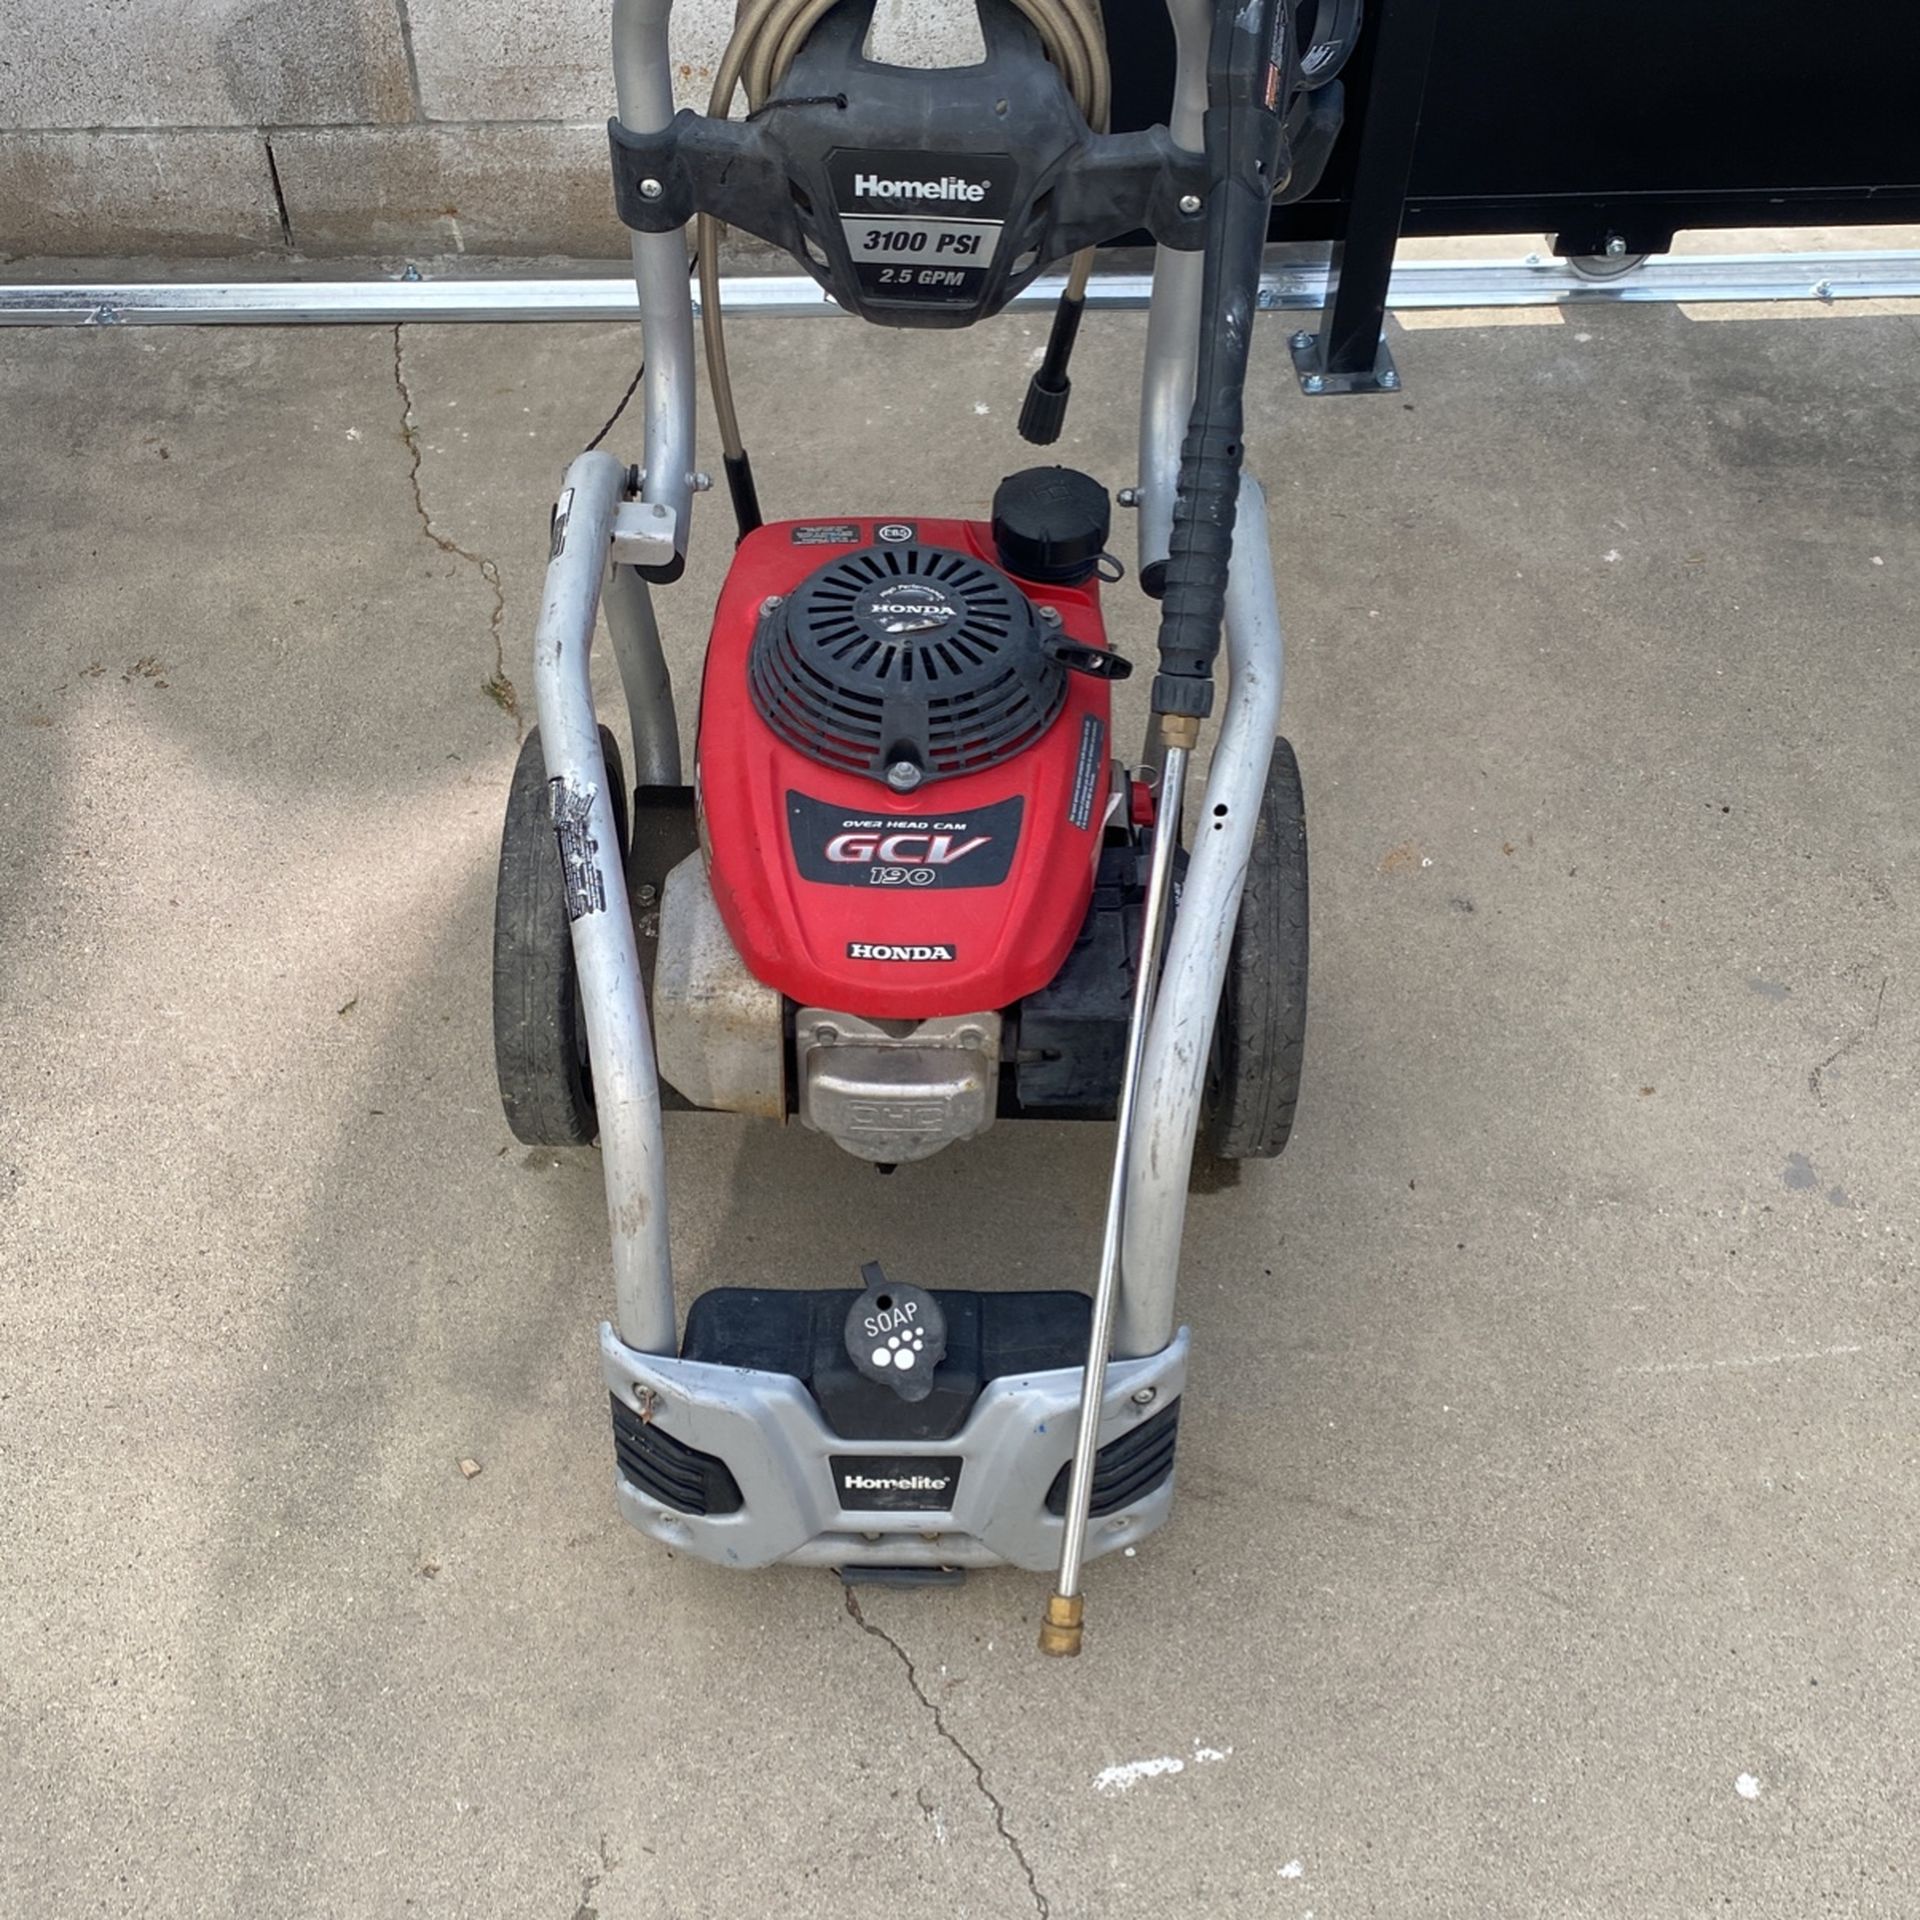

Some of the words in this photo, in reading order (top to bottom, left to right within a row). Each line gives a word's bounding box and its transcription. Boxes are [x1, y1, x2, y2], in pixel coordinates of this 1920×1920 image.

[855, 174, 985, 202] Homelite
[863, 230, 928, 252] 3100
[935, 233, 982, 255] PSI
[879, 269, 913, 284] 2.5
[918, 270, 965, 286] GPM
[871, 603, 957, 617] HONDA
[842, 820, 883, 829] OVER
[886, 821, 928, 830] HEAD
[933, 822, 967, 831] CAM
[825, 832, 993, 864] GCV
[870, 867, 936, 886] 190
[851, 944, 953, 961] HONDA
[864, 1302, 918, 1337] SOAP
[844, 1475, 946, 1491] Homelite
